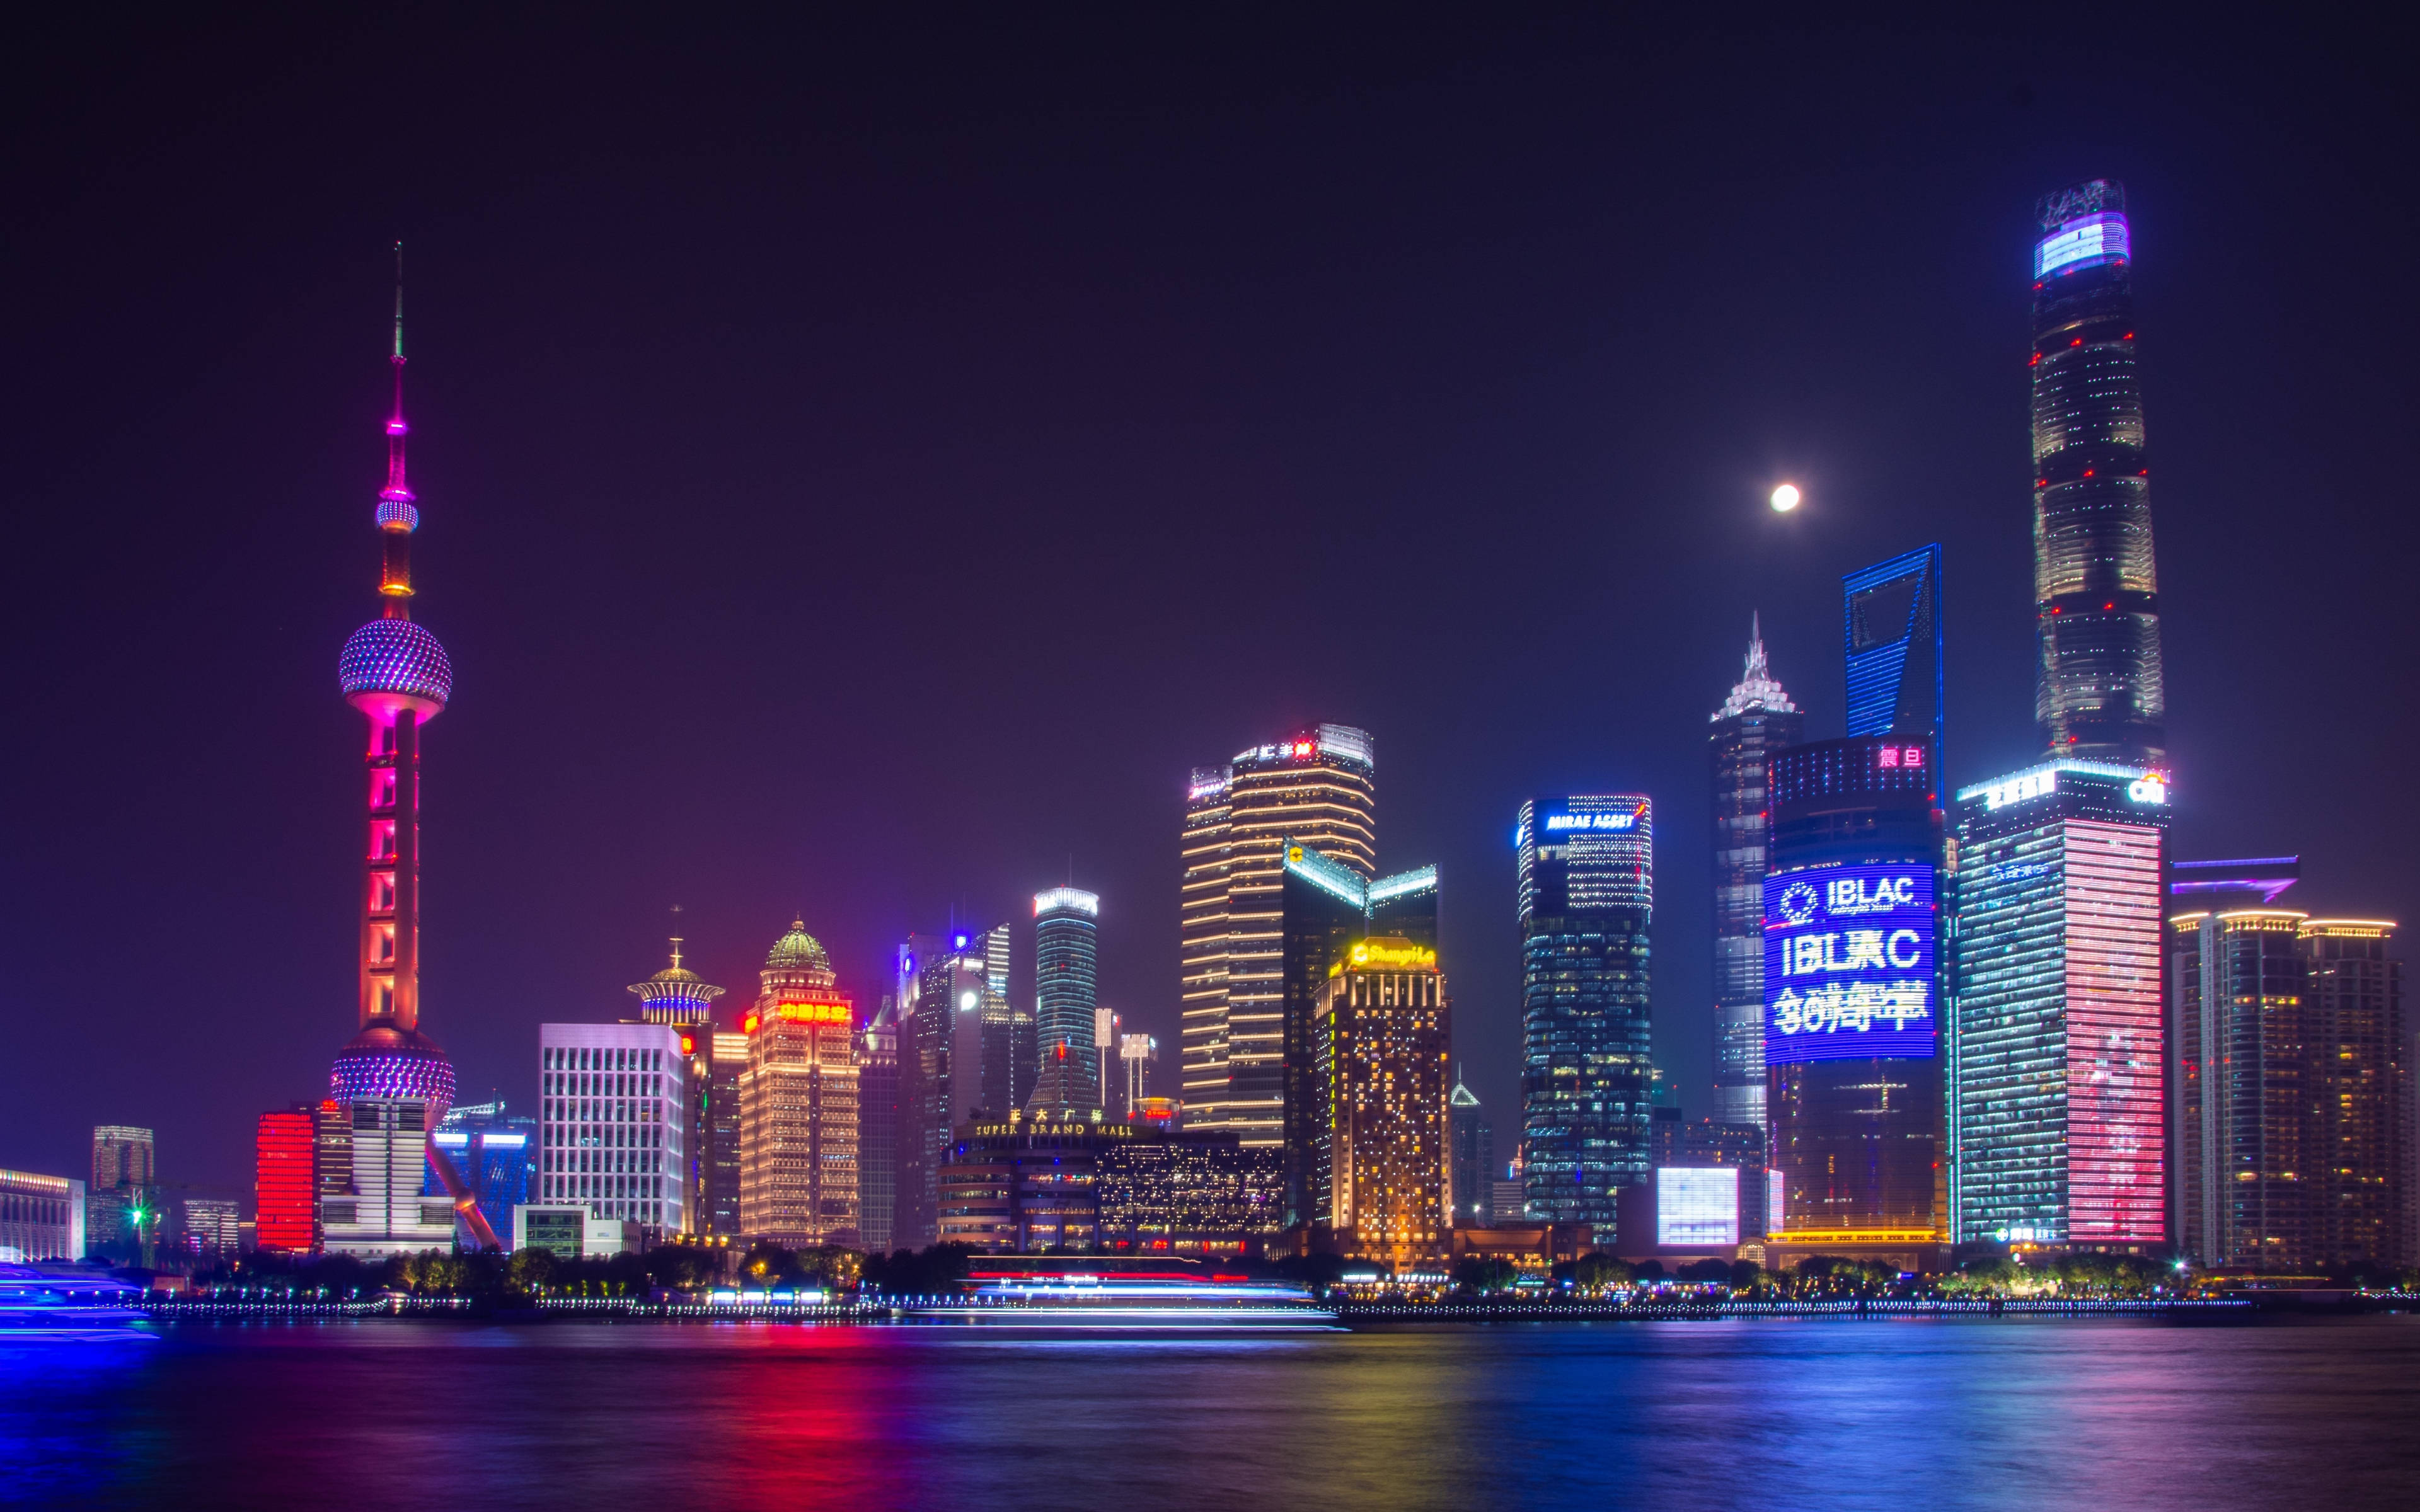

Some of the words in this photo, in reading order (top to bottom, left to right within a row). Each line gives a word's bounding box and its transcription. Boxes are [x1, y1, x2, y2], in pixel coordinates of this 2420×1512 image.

[1260, 745, 1293, 757] 汇丰
[1880, 748, 1922, 767] 震旦
[1547, 816, 1591, 830] MIRAE
[1593, 815, 1634, 829] ASSET
[1828, 878, 1914, 906] IBLAC
[1369, 945, 1435, 966] Shangri-La
[1010, 1109, 1102, 1122] 正大广场
[976, 1125, 1017, 1135] SUPER
[1030, 1125, 1084, 1135] BRAND
[1097, 1125, 1133, 1137] MALL
